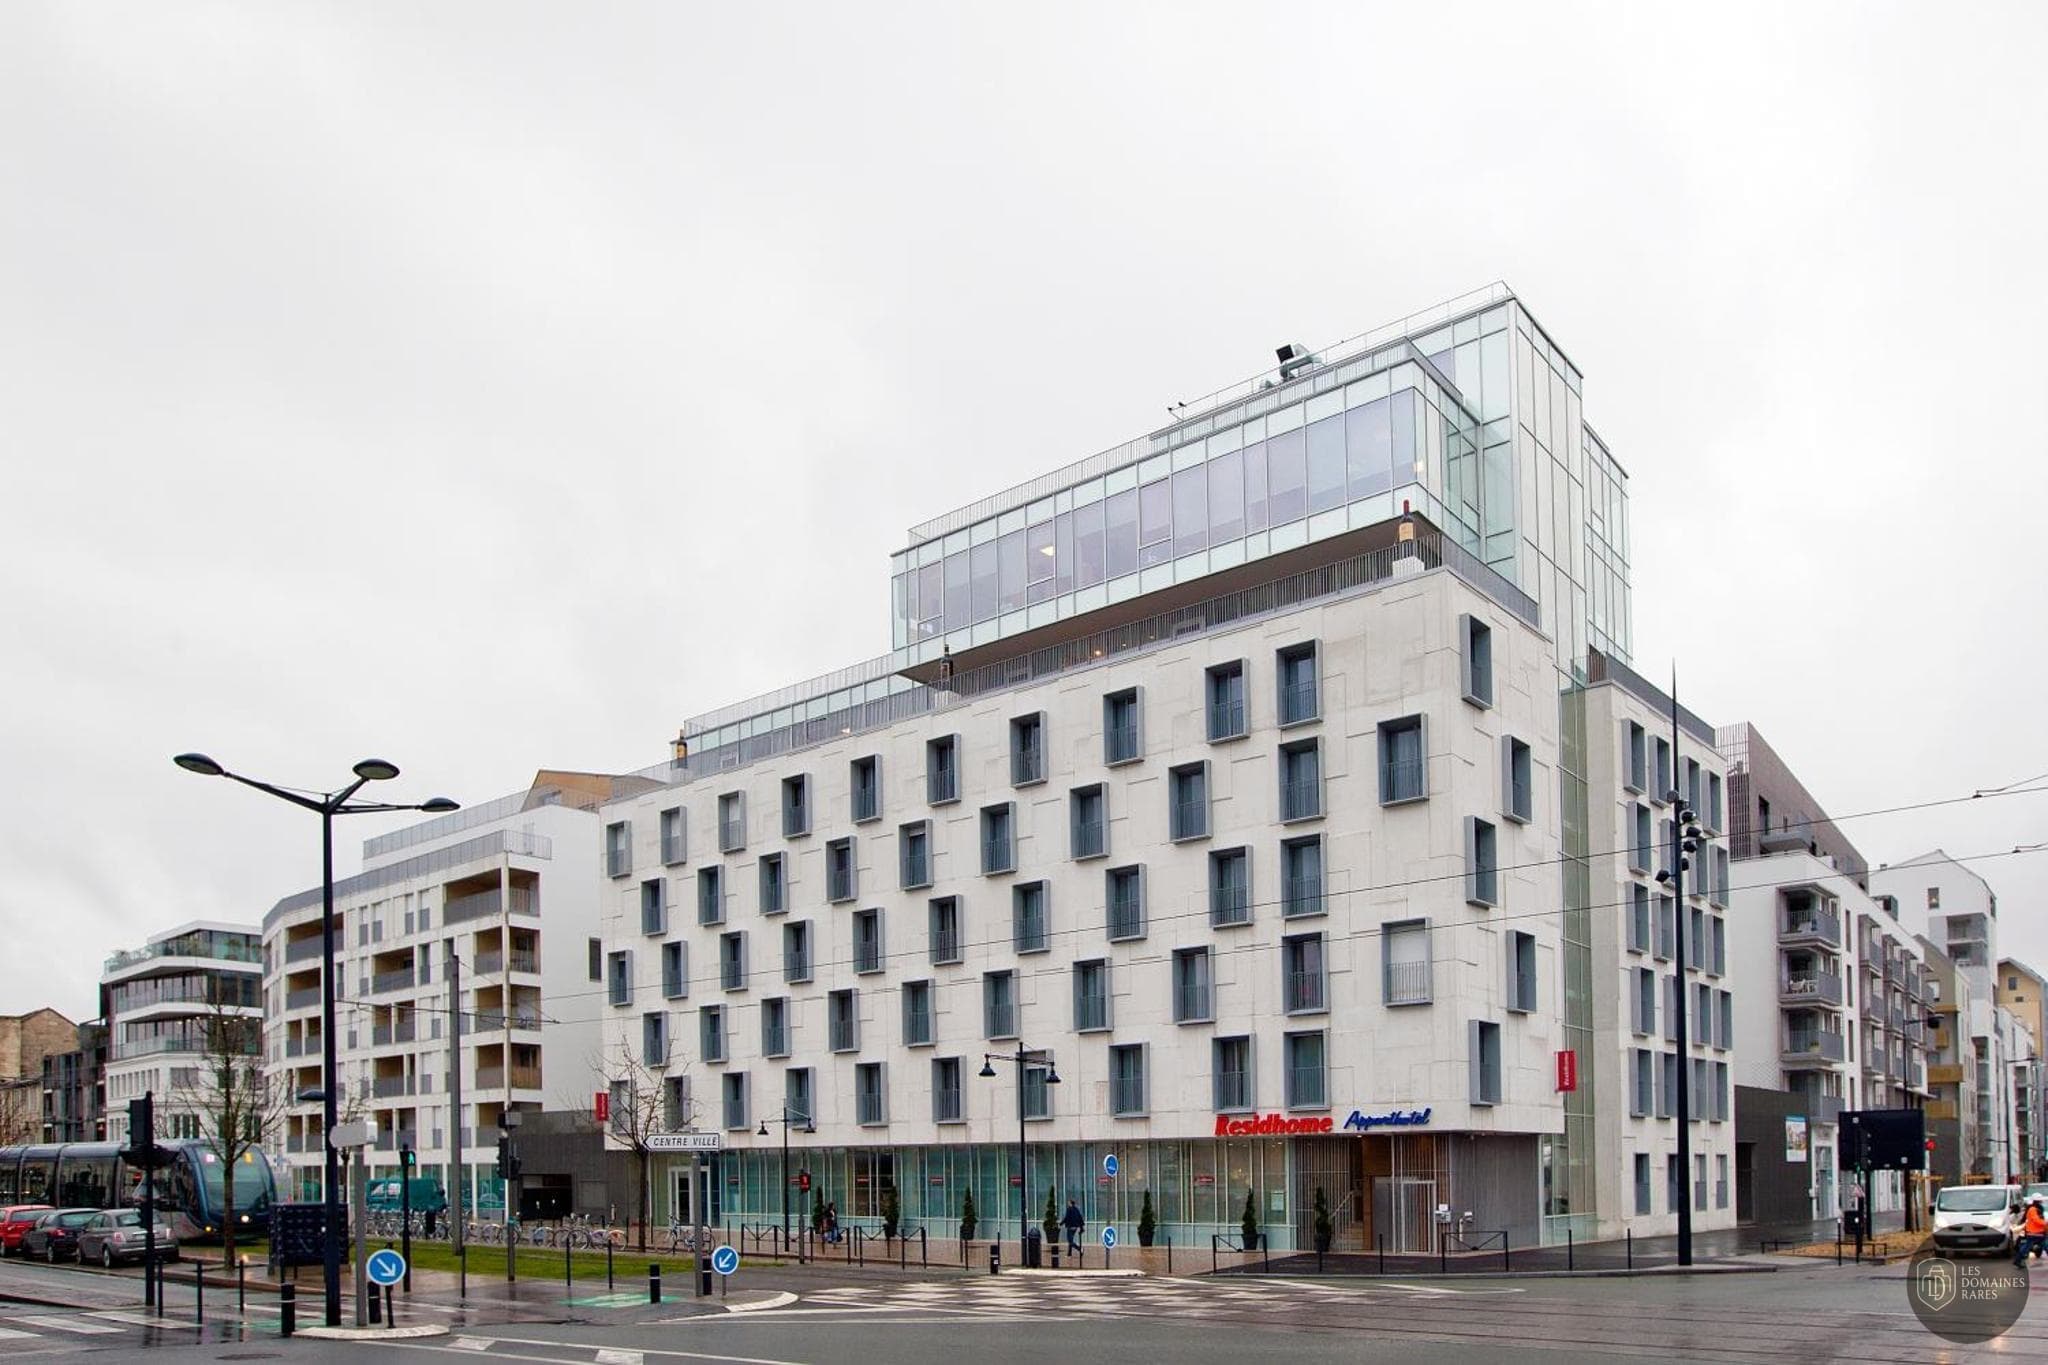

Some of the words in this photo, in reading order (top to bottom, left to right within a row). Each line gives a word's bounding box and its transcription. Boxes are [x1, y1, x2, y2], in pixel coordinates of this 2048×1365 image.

[1215, 1112, 1334, 1136] Residhome
[653, 1137, 688, 1146] CENTRE
[693, 1137, 717, 1146] VILLE
